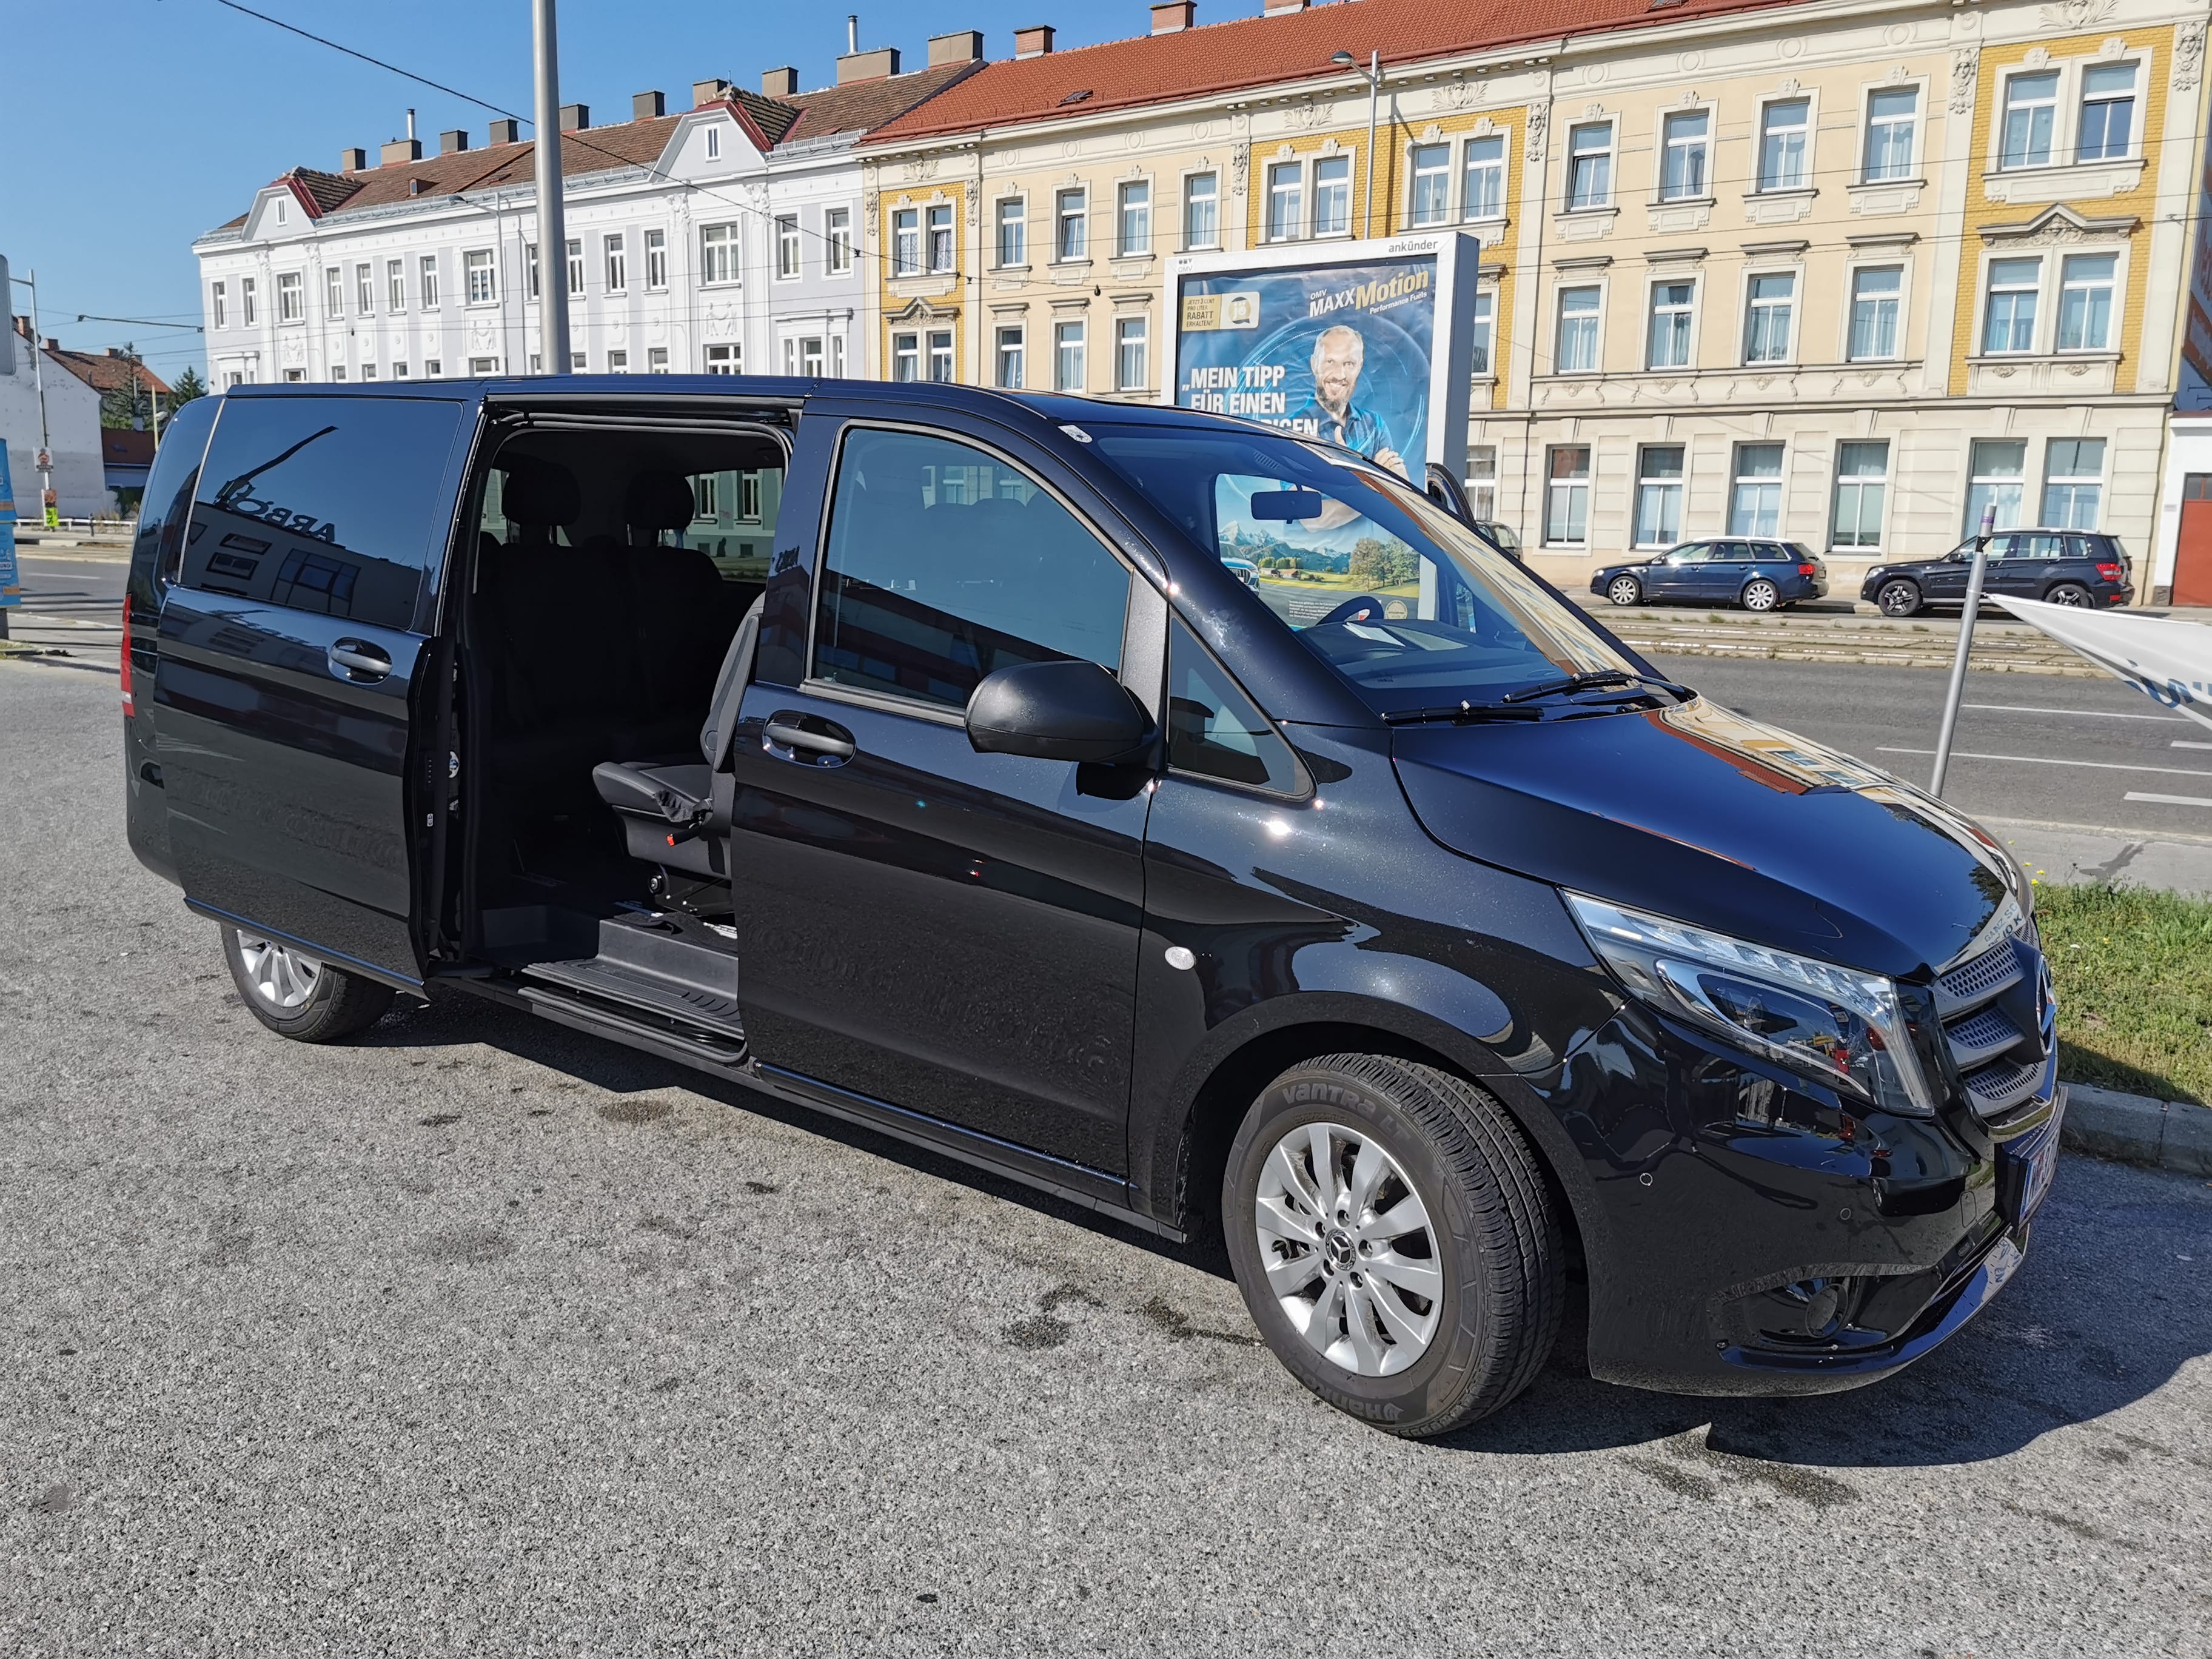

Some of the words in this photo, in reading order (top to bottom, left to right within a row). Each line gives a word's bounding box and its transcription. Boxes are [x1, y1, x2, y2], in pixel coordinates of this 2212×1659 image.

[1388, 240, 1439, 253] ankünder
[1310, 289, 1327, 300] OMV
[1369, 296, 1409, 315] Performance
[1409, 290, 1427, 302] Fuels
[1187, 310, 1213, 320] RABATT
[1242, 366, 1285, 388] TIPP
[1190, 389, 1224, 414] FÜR
[1228, 392, 1286, 415] EINEN
